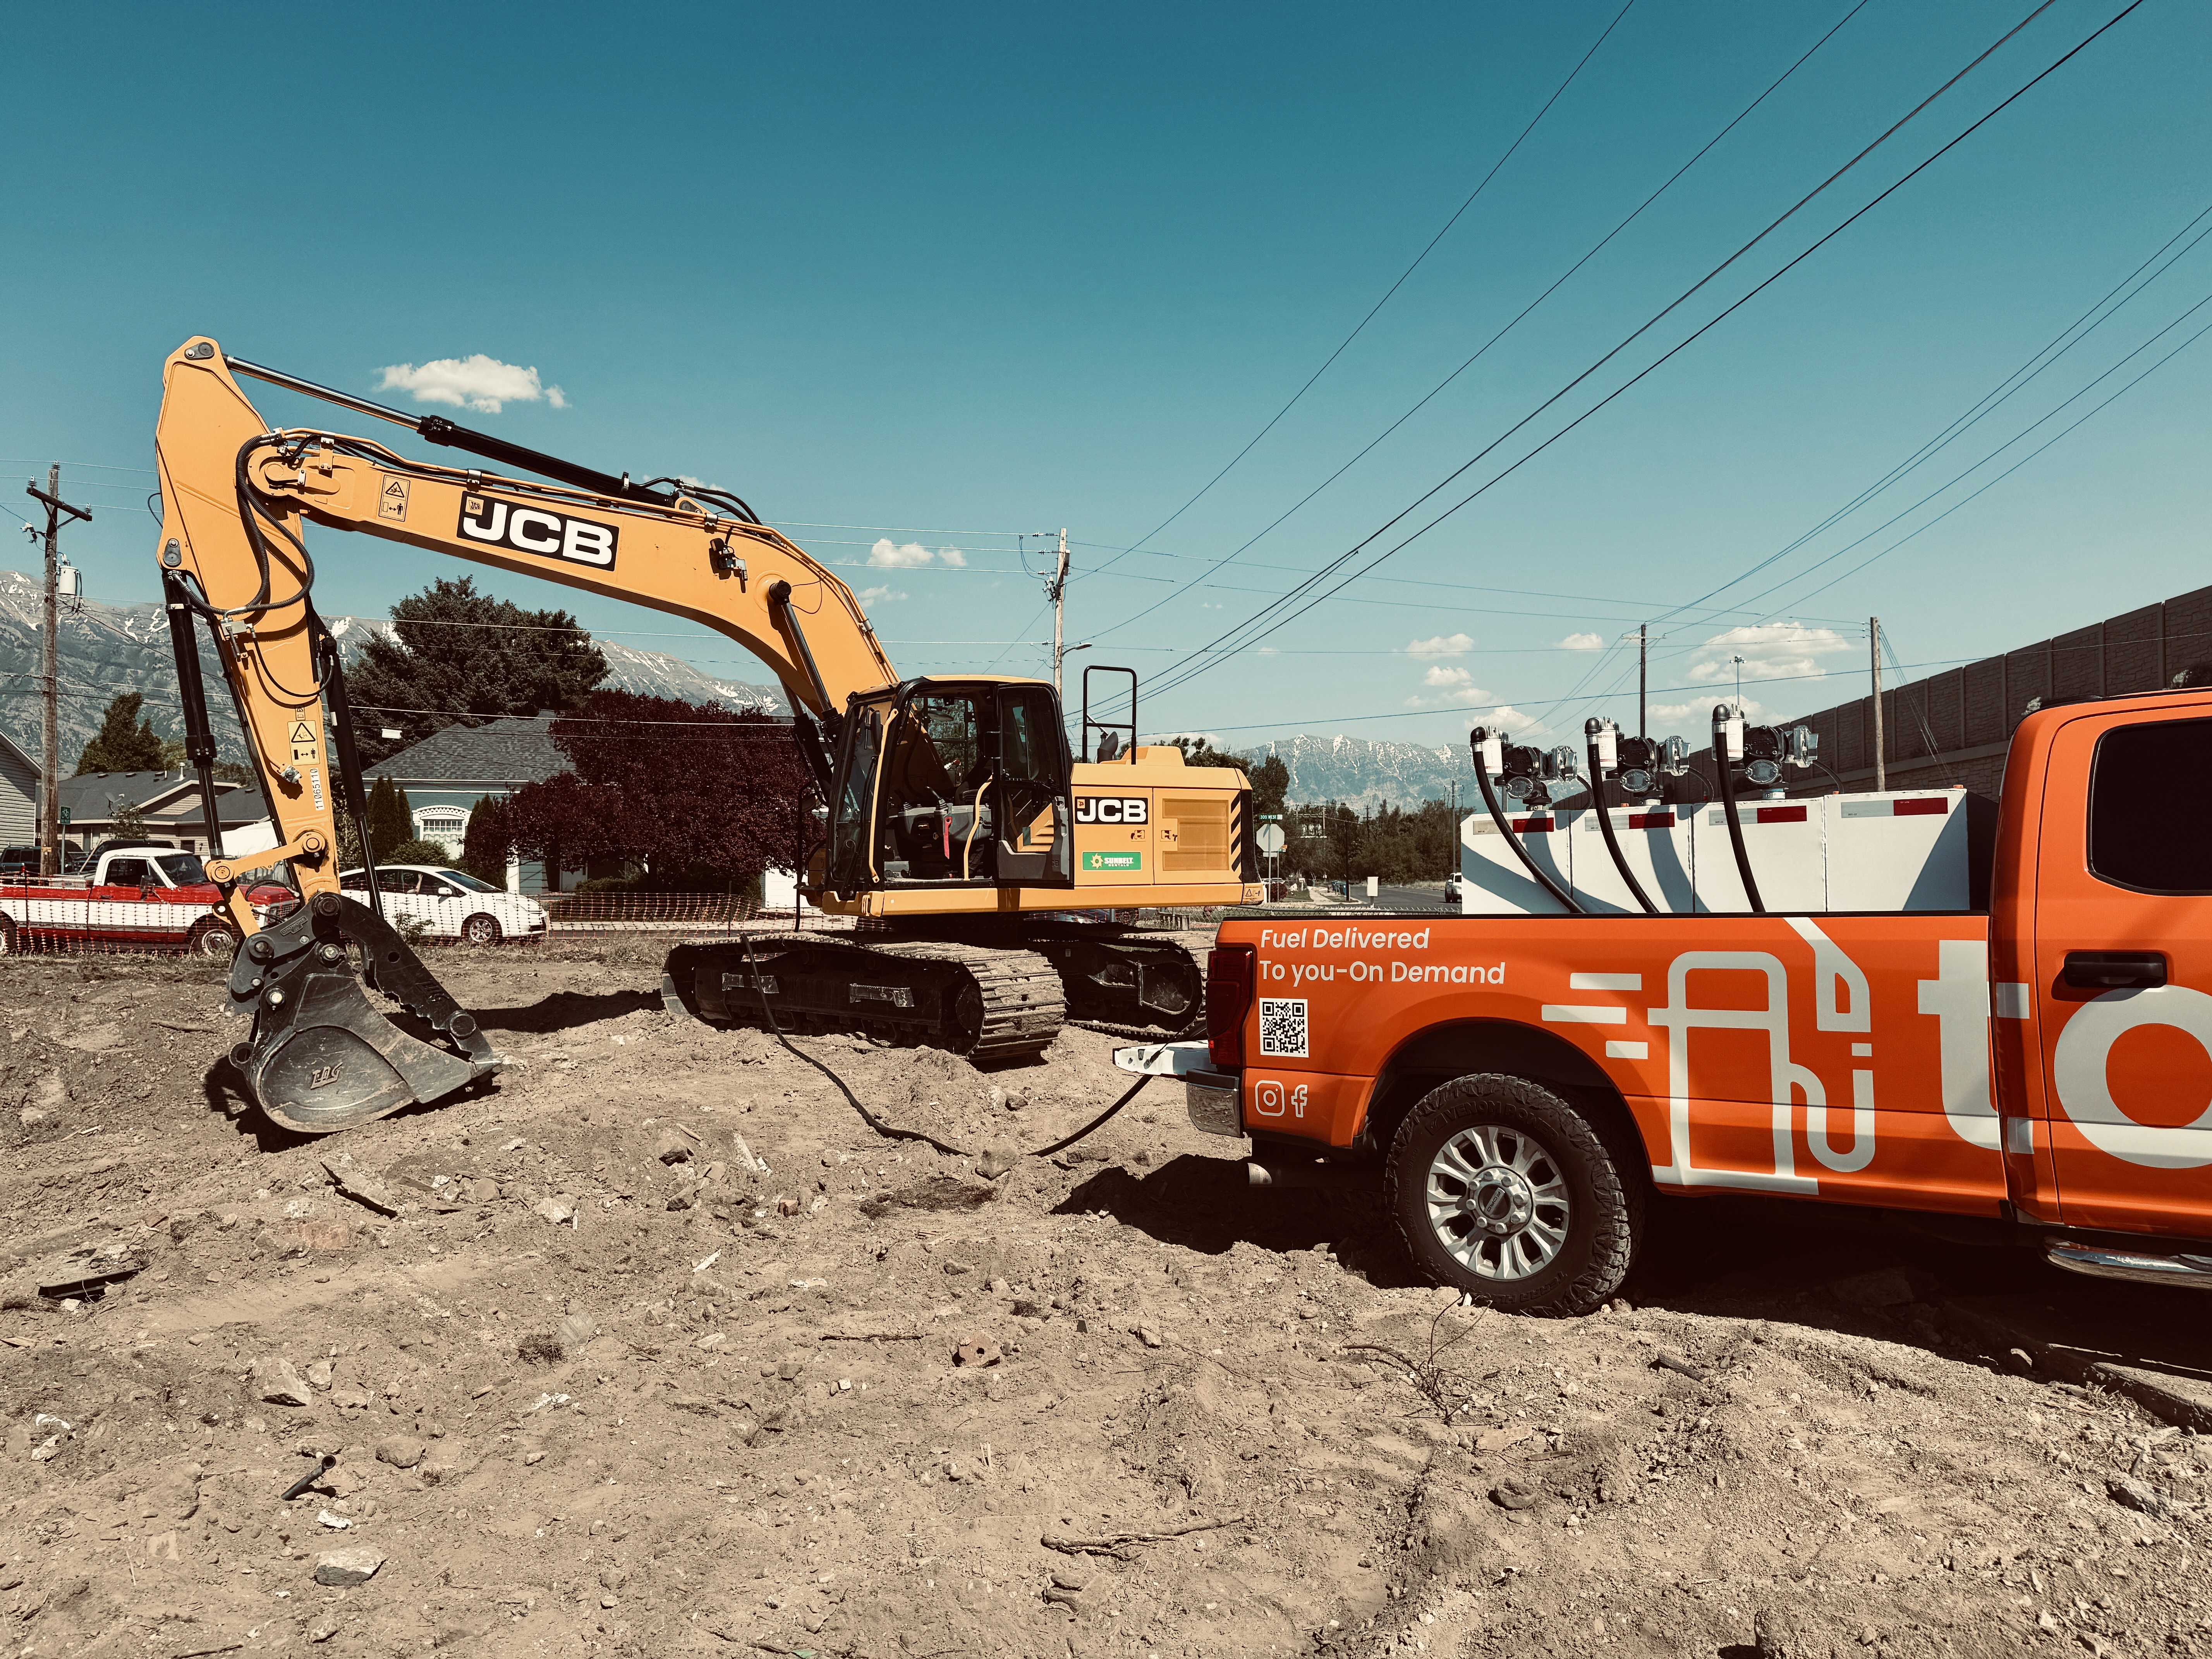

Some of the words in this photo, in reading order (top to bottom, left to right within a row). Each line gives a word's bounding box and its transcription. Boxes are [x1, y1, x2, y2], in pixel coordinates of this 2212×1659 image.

[463, 502, 613, 565] JCB
[310, 768, 323, 809] 11065110
[1077, 799, 1146, 822] JCB
[1261, 928, 1308, 948] Fuel
[1313, 927, 1430, 949] Delivered
[1259, 960, 1286, 980] To
[1291, 961, 1383, 987] you-On
[1391, 961, 1506, 984] Demand
[1443, 1100, 1501, 1121] VENOM
[1505, 1103, 1559, 1143] POWER
[1487, 1191, 1501, 1212] FORD
[1519, 1271, 1568, 1304] TERRA
